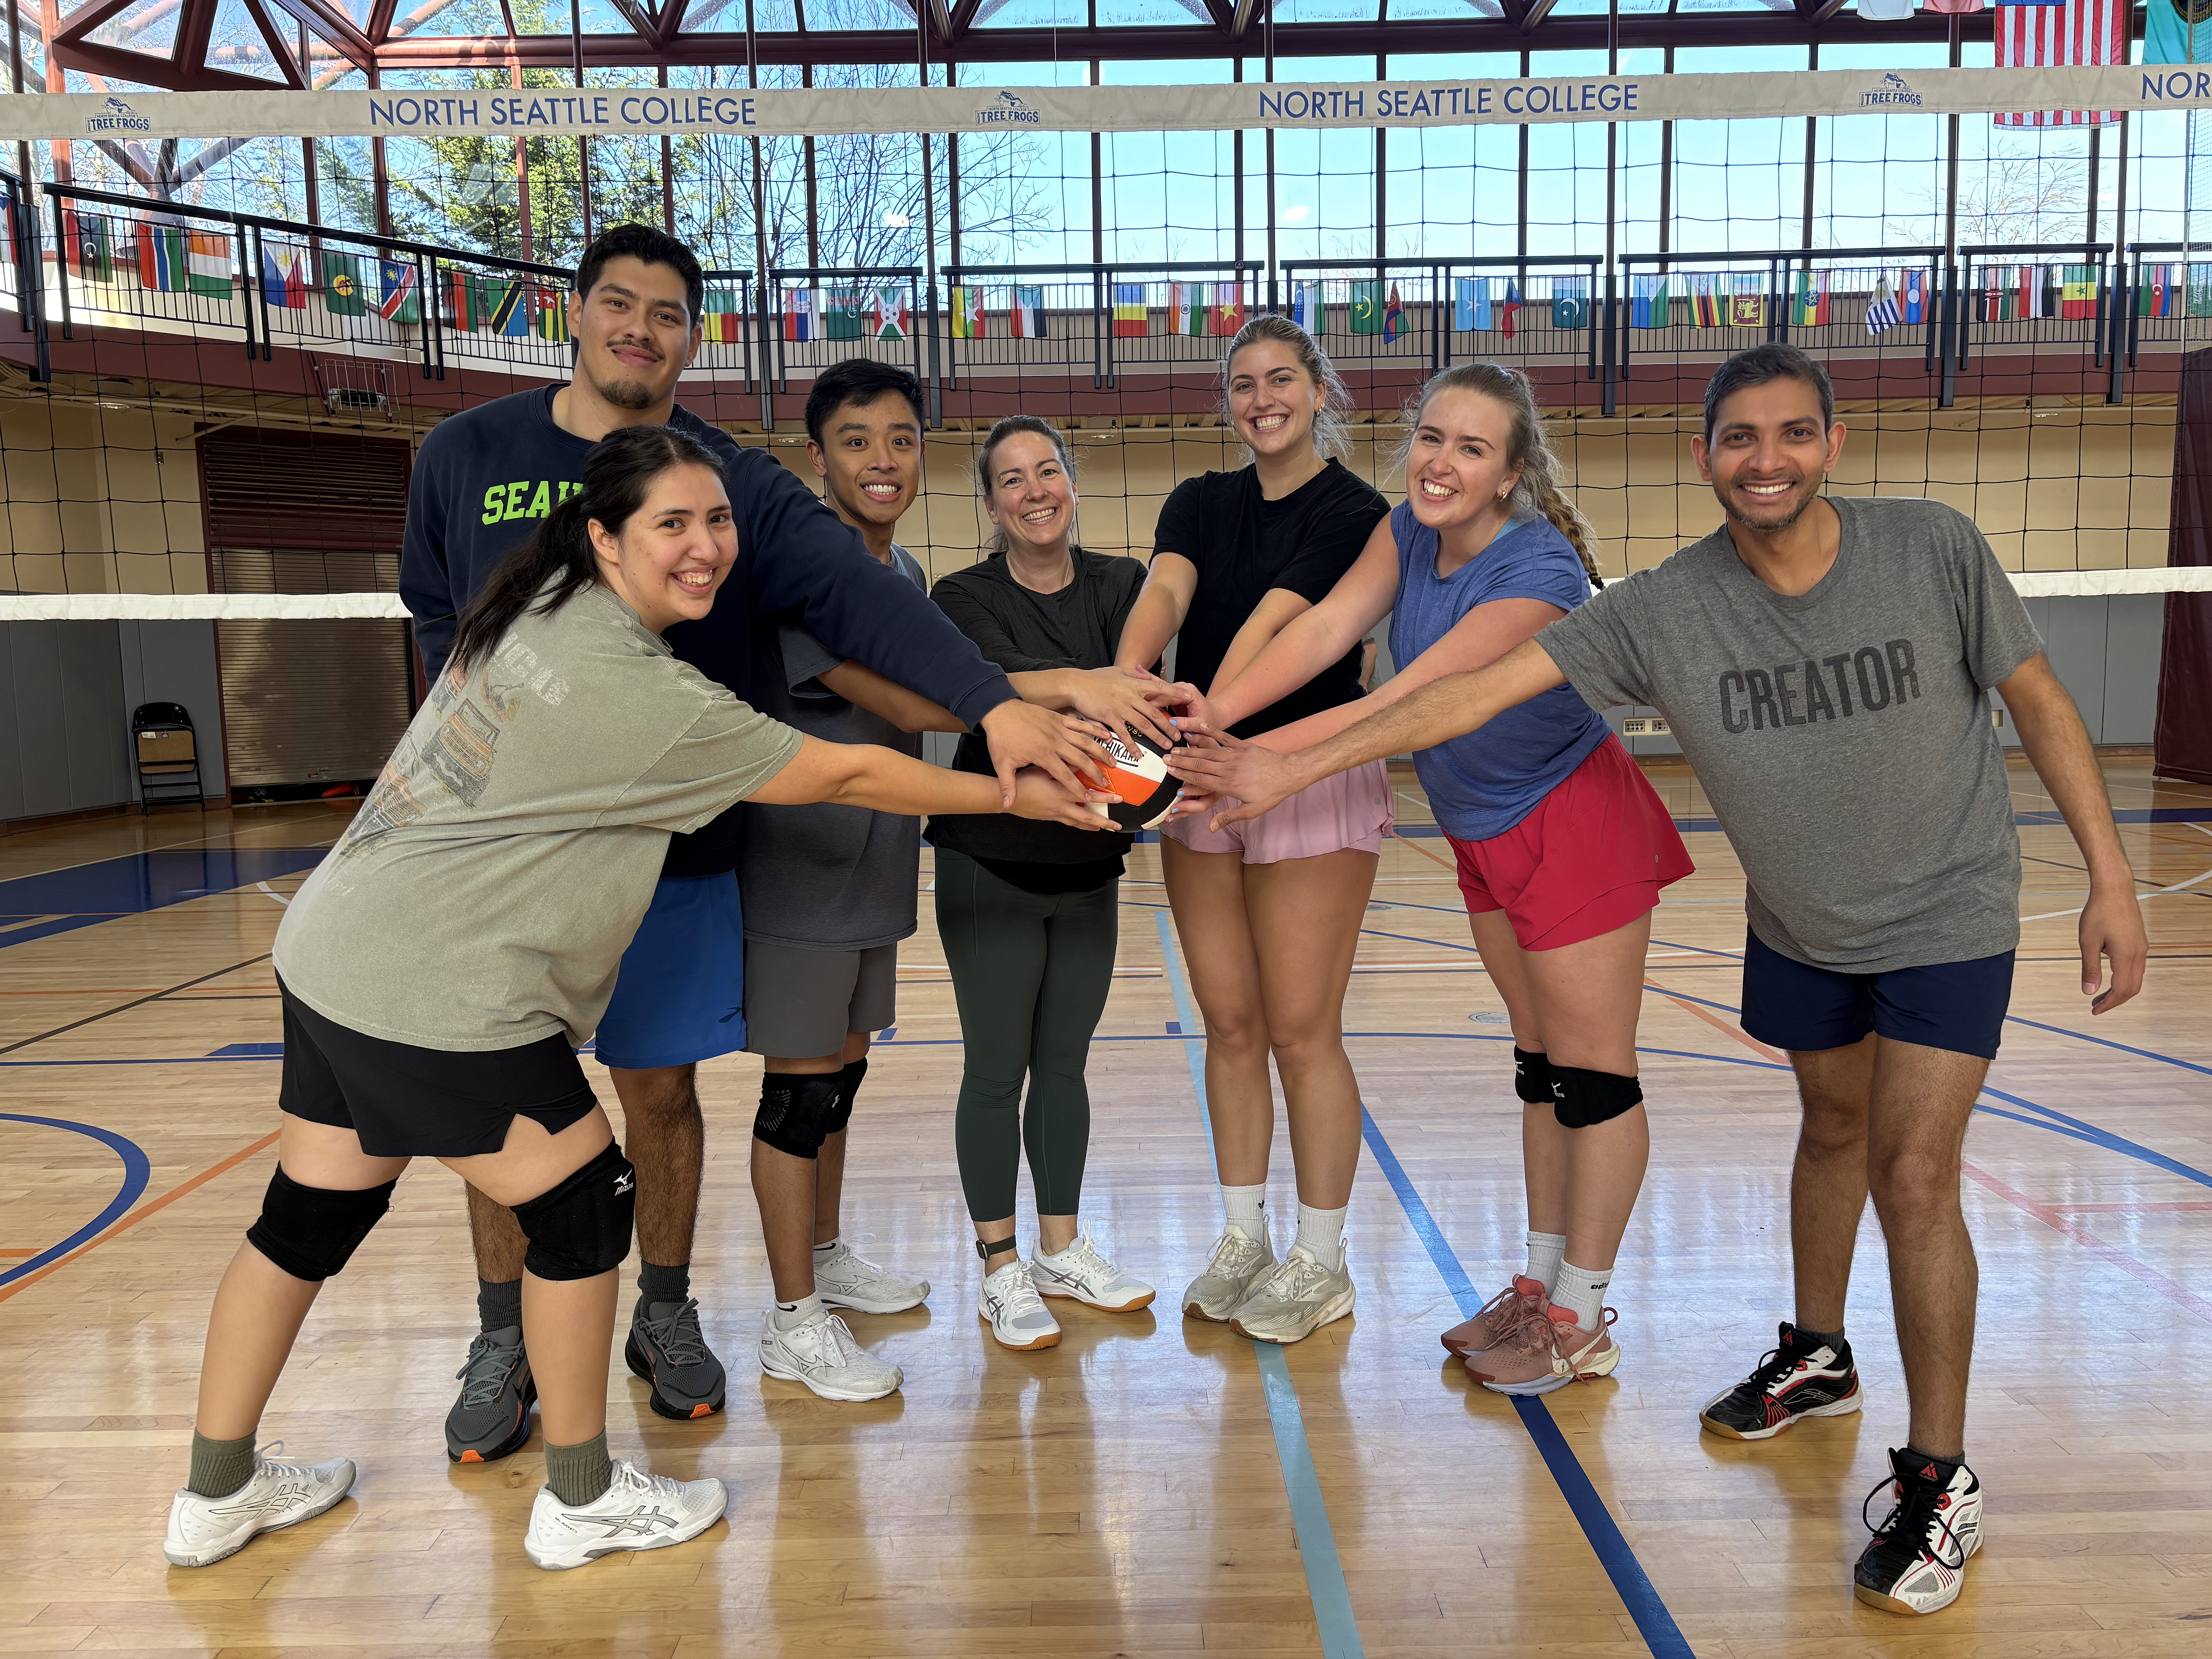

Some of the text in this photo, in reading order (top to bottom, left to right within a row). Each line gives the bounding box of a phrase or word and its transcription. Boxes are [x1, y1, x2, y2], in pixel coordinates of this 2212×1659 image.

[1260, 84, 1638, 118] NORTH SEATTLE COLLEGE
[1865, 93, 1891, 105] TREE
[1893, 93, 1921, 105] FROGS
[370, 96, 756, 126] NORTH SEATTLE COLLEGE
[981, 111, 1006, 122] TREE
[1008, 111, 1039, 123] FROGS
[90, 118, 115, 131] TREE
[116, 118, 149, 130] FROGS
[1719, 639, 1921, 734] CREATOR
